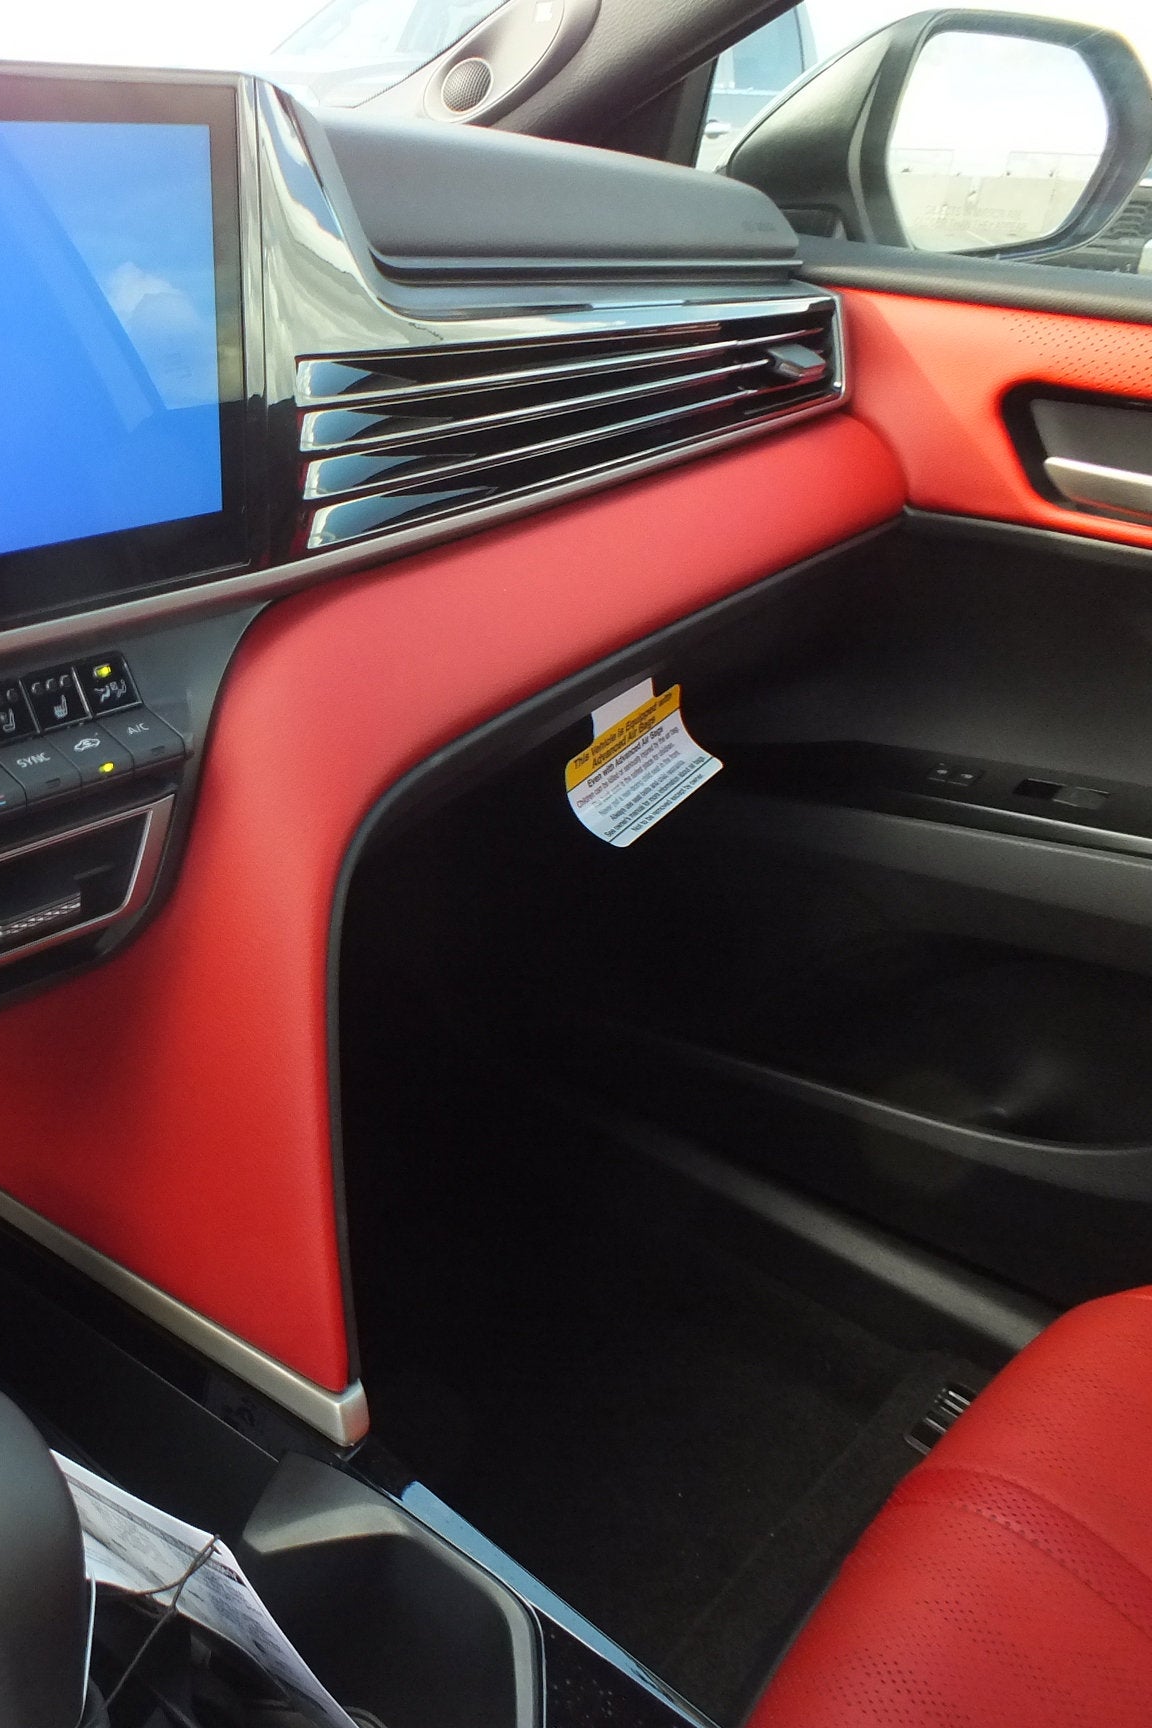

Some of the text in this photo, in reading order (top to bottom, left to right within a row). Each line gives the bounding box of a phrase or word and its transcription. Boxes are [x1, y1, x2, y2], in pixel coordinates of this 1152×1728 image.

[127, 722, 150, 736] A/C
[16, 751, 51, 768] SYNC
[616, 743, 640, 766] Advanced
